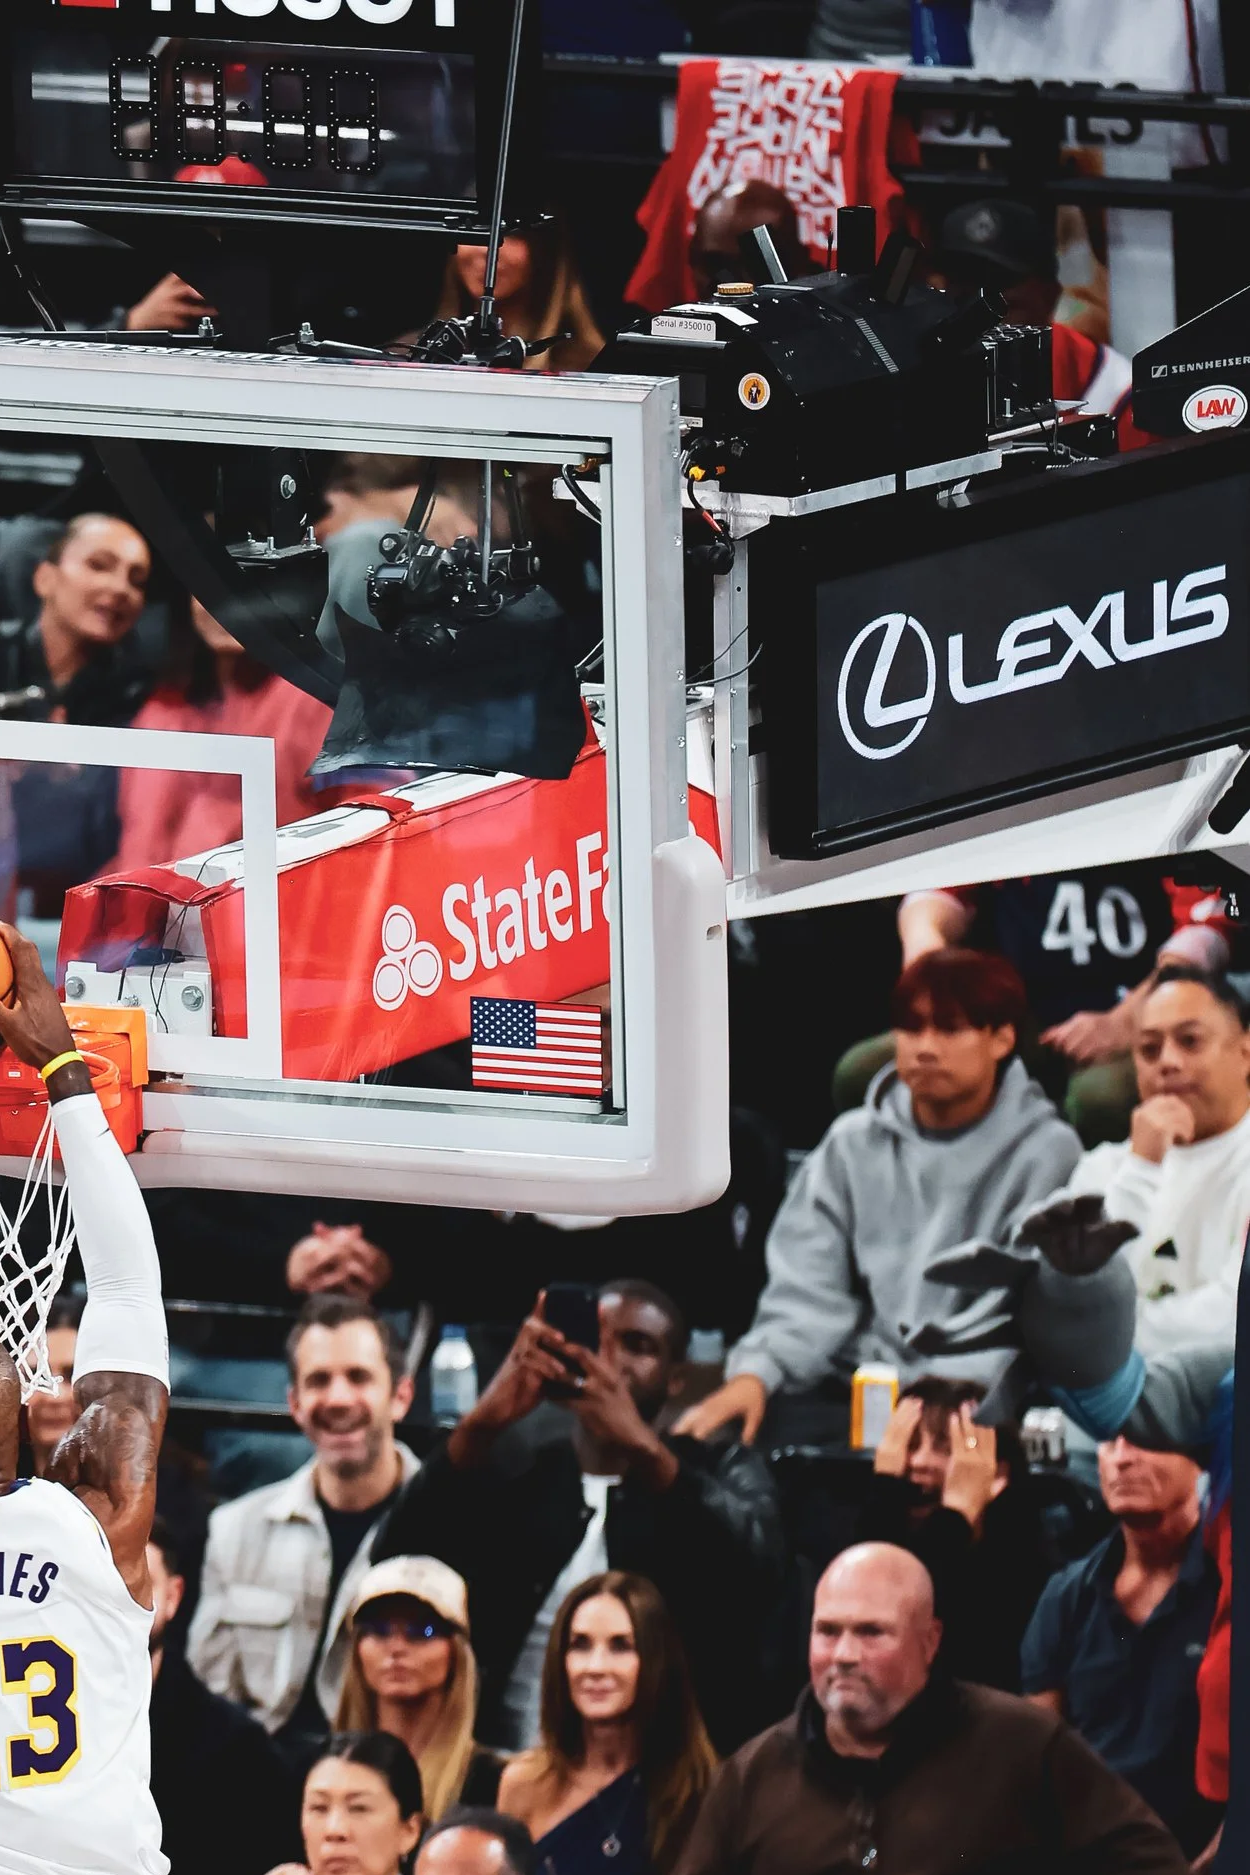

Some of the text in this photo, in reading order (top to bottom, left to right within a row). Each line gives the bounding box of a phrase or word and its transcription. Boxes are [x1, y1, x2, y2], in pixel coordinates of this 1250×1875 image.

[939, 76, 1143, 145] JAES
[655, 318, 712, 332] Serial #350010
[1171, 356, 1250, 374] SENNHEISER
[1197, 397, 1236, 419] LAW
[948, 564, 1230, 704] LEXUS
[1041, 879, 1147, 966] 40
